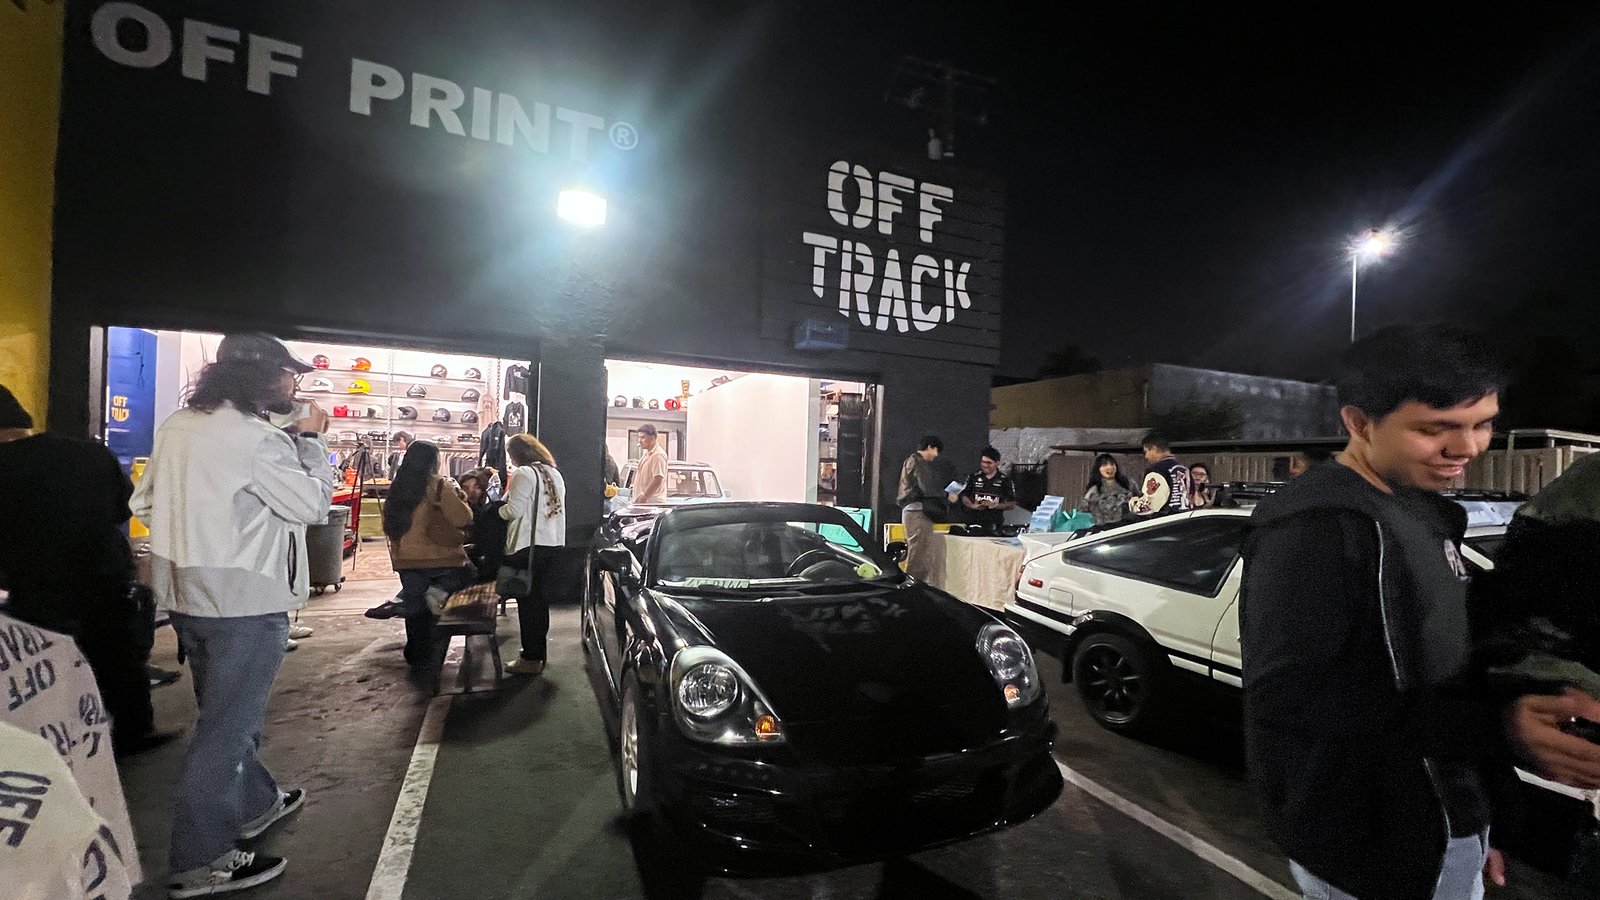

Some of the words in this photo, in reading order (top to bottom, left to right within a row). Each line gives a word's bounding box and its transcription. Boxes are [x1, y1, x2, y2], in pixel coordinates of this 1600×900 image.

[90, 1, 303, 95] OFF
[827, 160, 954, 243] OFF
[802, 231, 971, 333] TRACK
[8, 659, 56, 711] OFF
